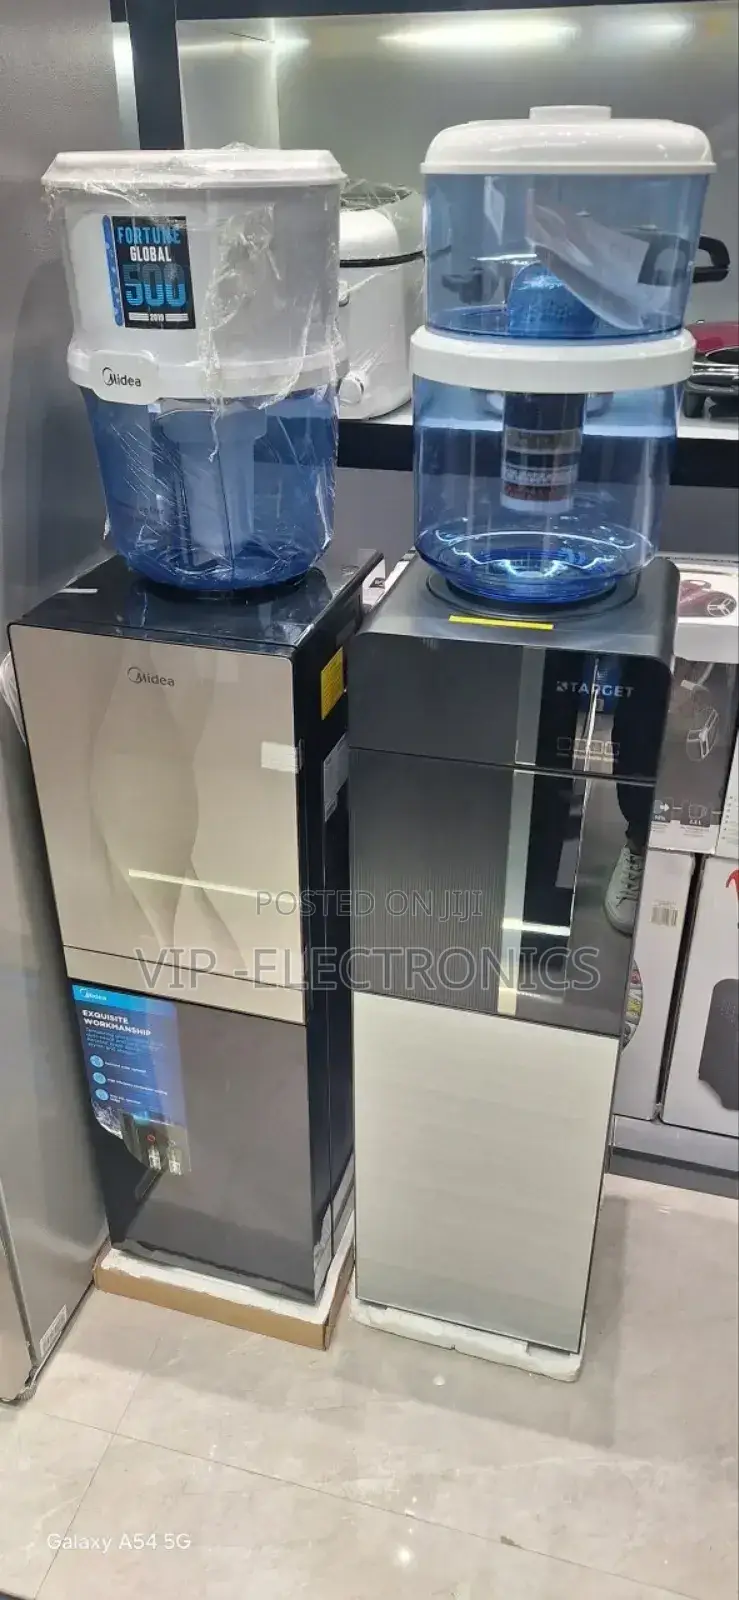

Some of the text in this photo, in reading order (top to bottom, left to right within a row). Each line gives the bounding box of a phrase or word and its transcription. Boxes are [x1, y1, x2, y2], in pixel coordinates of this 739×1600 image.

[116, 226, 181, 245] FORTUNE
[129, 246, 172, 262] GLOBAL
[122, 264, 187, 307] 500
[102, 367, 141, 387] Midea
[127, 666, 175, 687] Midea
[570, 681, 634, 698] TARGET
[82, 1009, 129, 1025] EXQUISITE
[83, 1018, 151, 1036] WORKMANSHIP
